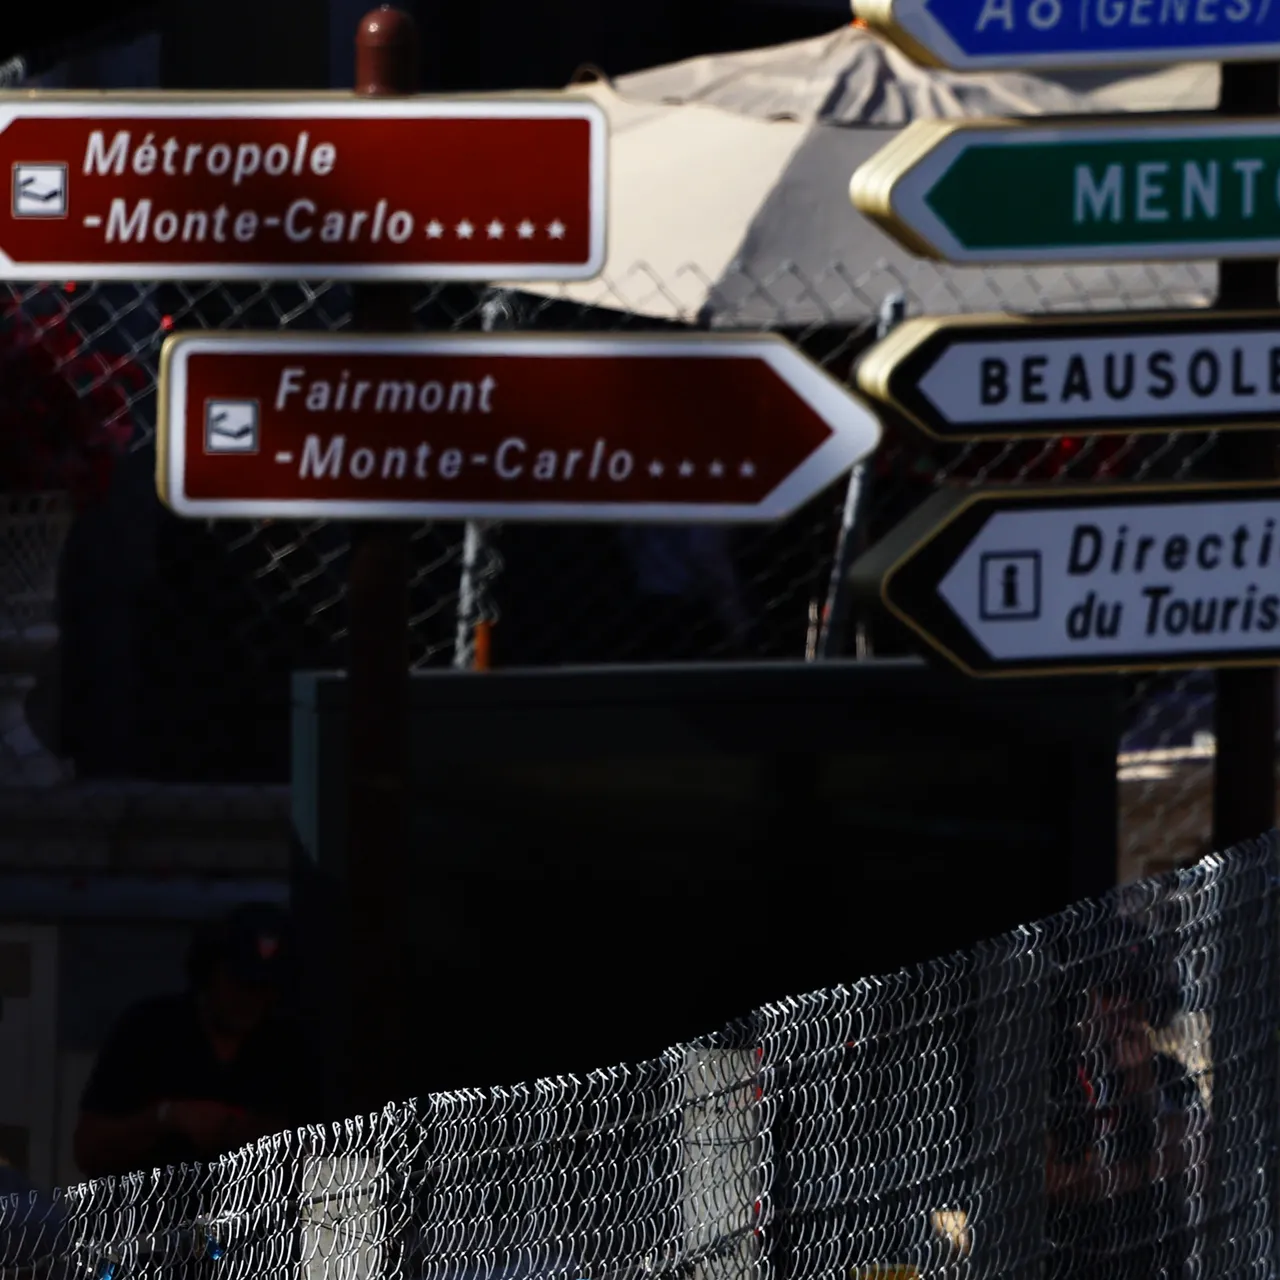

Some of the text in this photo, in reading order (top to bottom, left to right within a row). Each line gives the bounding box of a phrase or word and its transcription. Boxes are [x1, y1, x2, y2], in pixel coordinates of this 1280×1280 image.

[83, 128, 338, 184] Métropole
[272, 365, 499, 415] Fairmont
[1065, 590, 1123, 640] du
